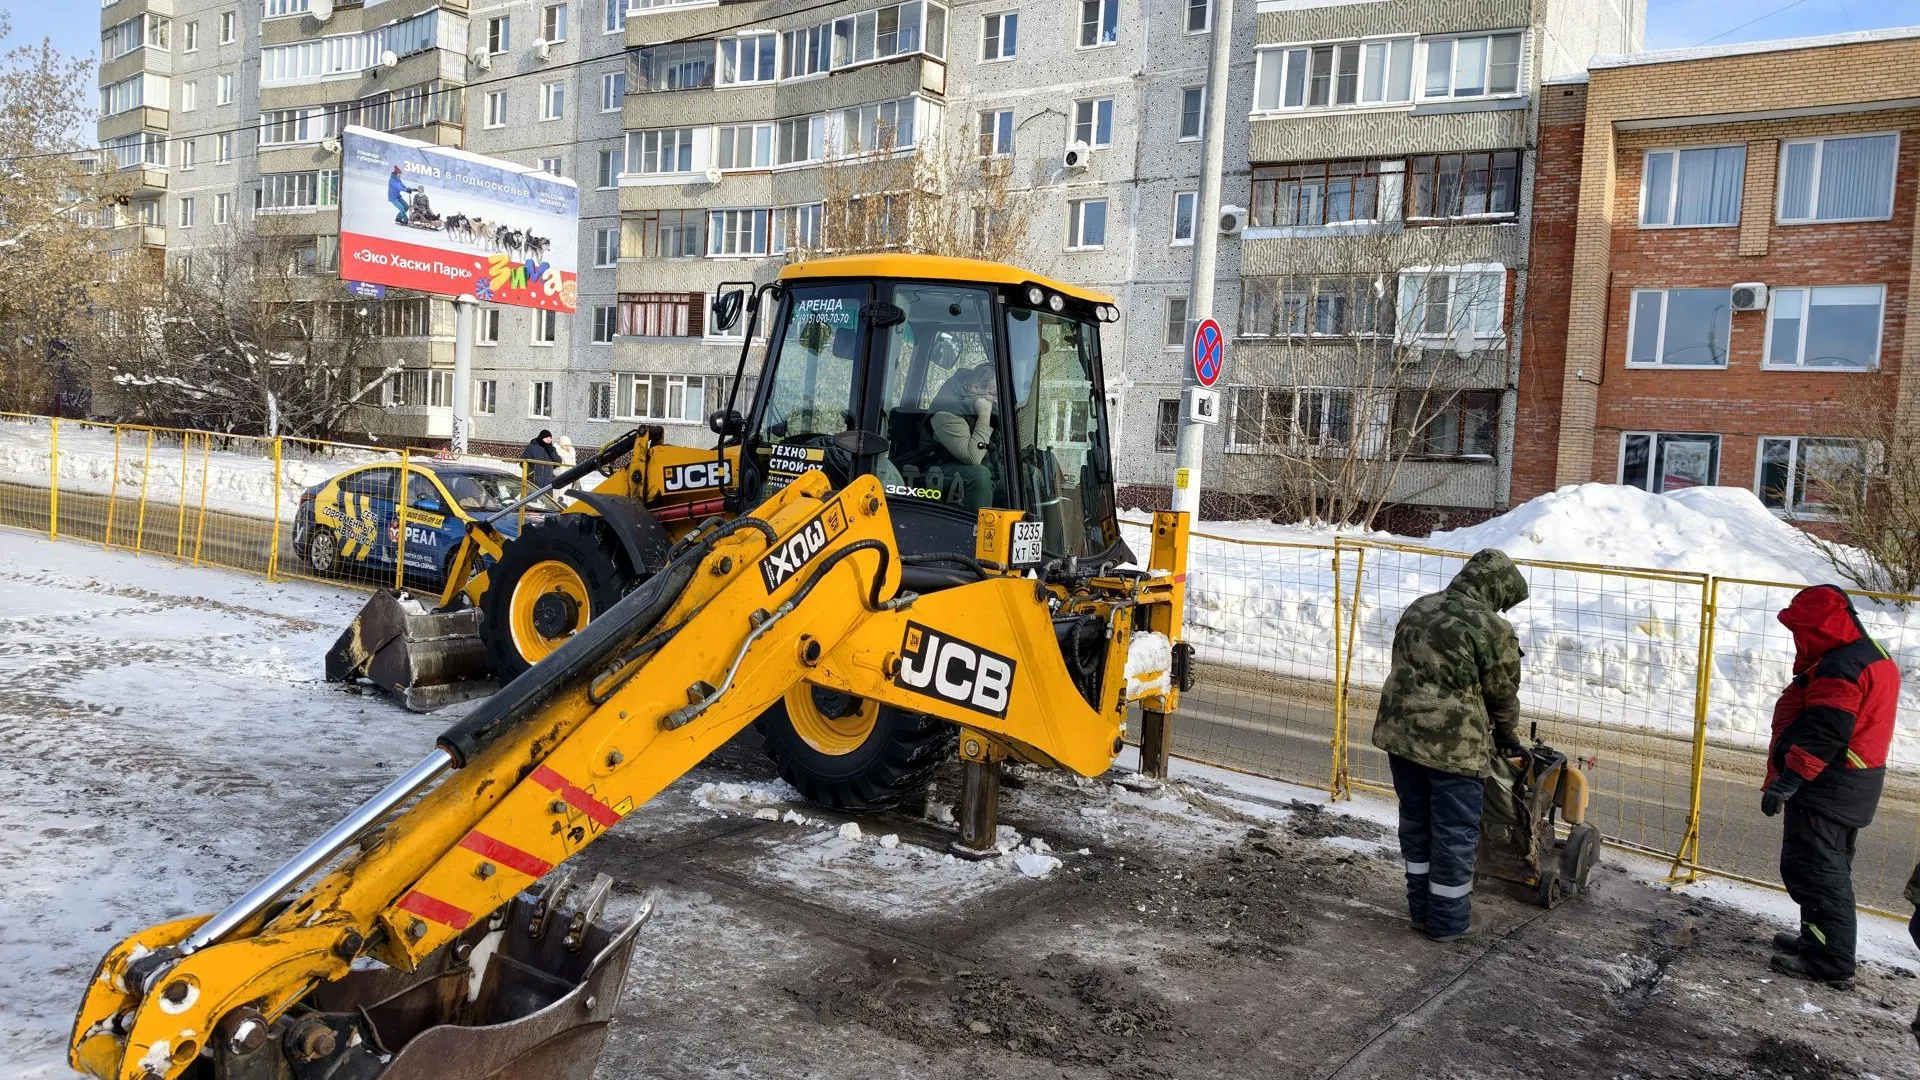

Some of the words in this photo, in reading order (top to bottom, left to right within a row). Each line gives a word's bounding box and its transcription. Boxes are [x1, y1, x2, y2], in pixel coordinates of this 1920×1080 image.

[353, 248, 388, 266] «Эко
[390, 254, 431, 273] Хаски
[433, 261, 473, 280] Парк»
[798, 298, 843, 312] АРЕНДА
[771, 444, 807, 460] ТЕХНО
[665, 461, 731, 490] JCB
[405, 526, 437, 547] РЕАЛ
[1018, 524, 1040, 541] 3235
[1031, 543, 1040, 556] 50
[900, 634, 1011, 712] JCB
